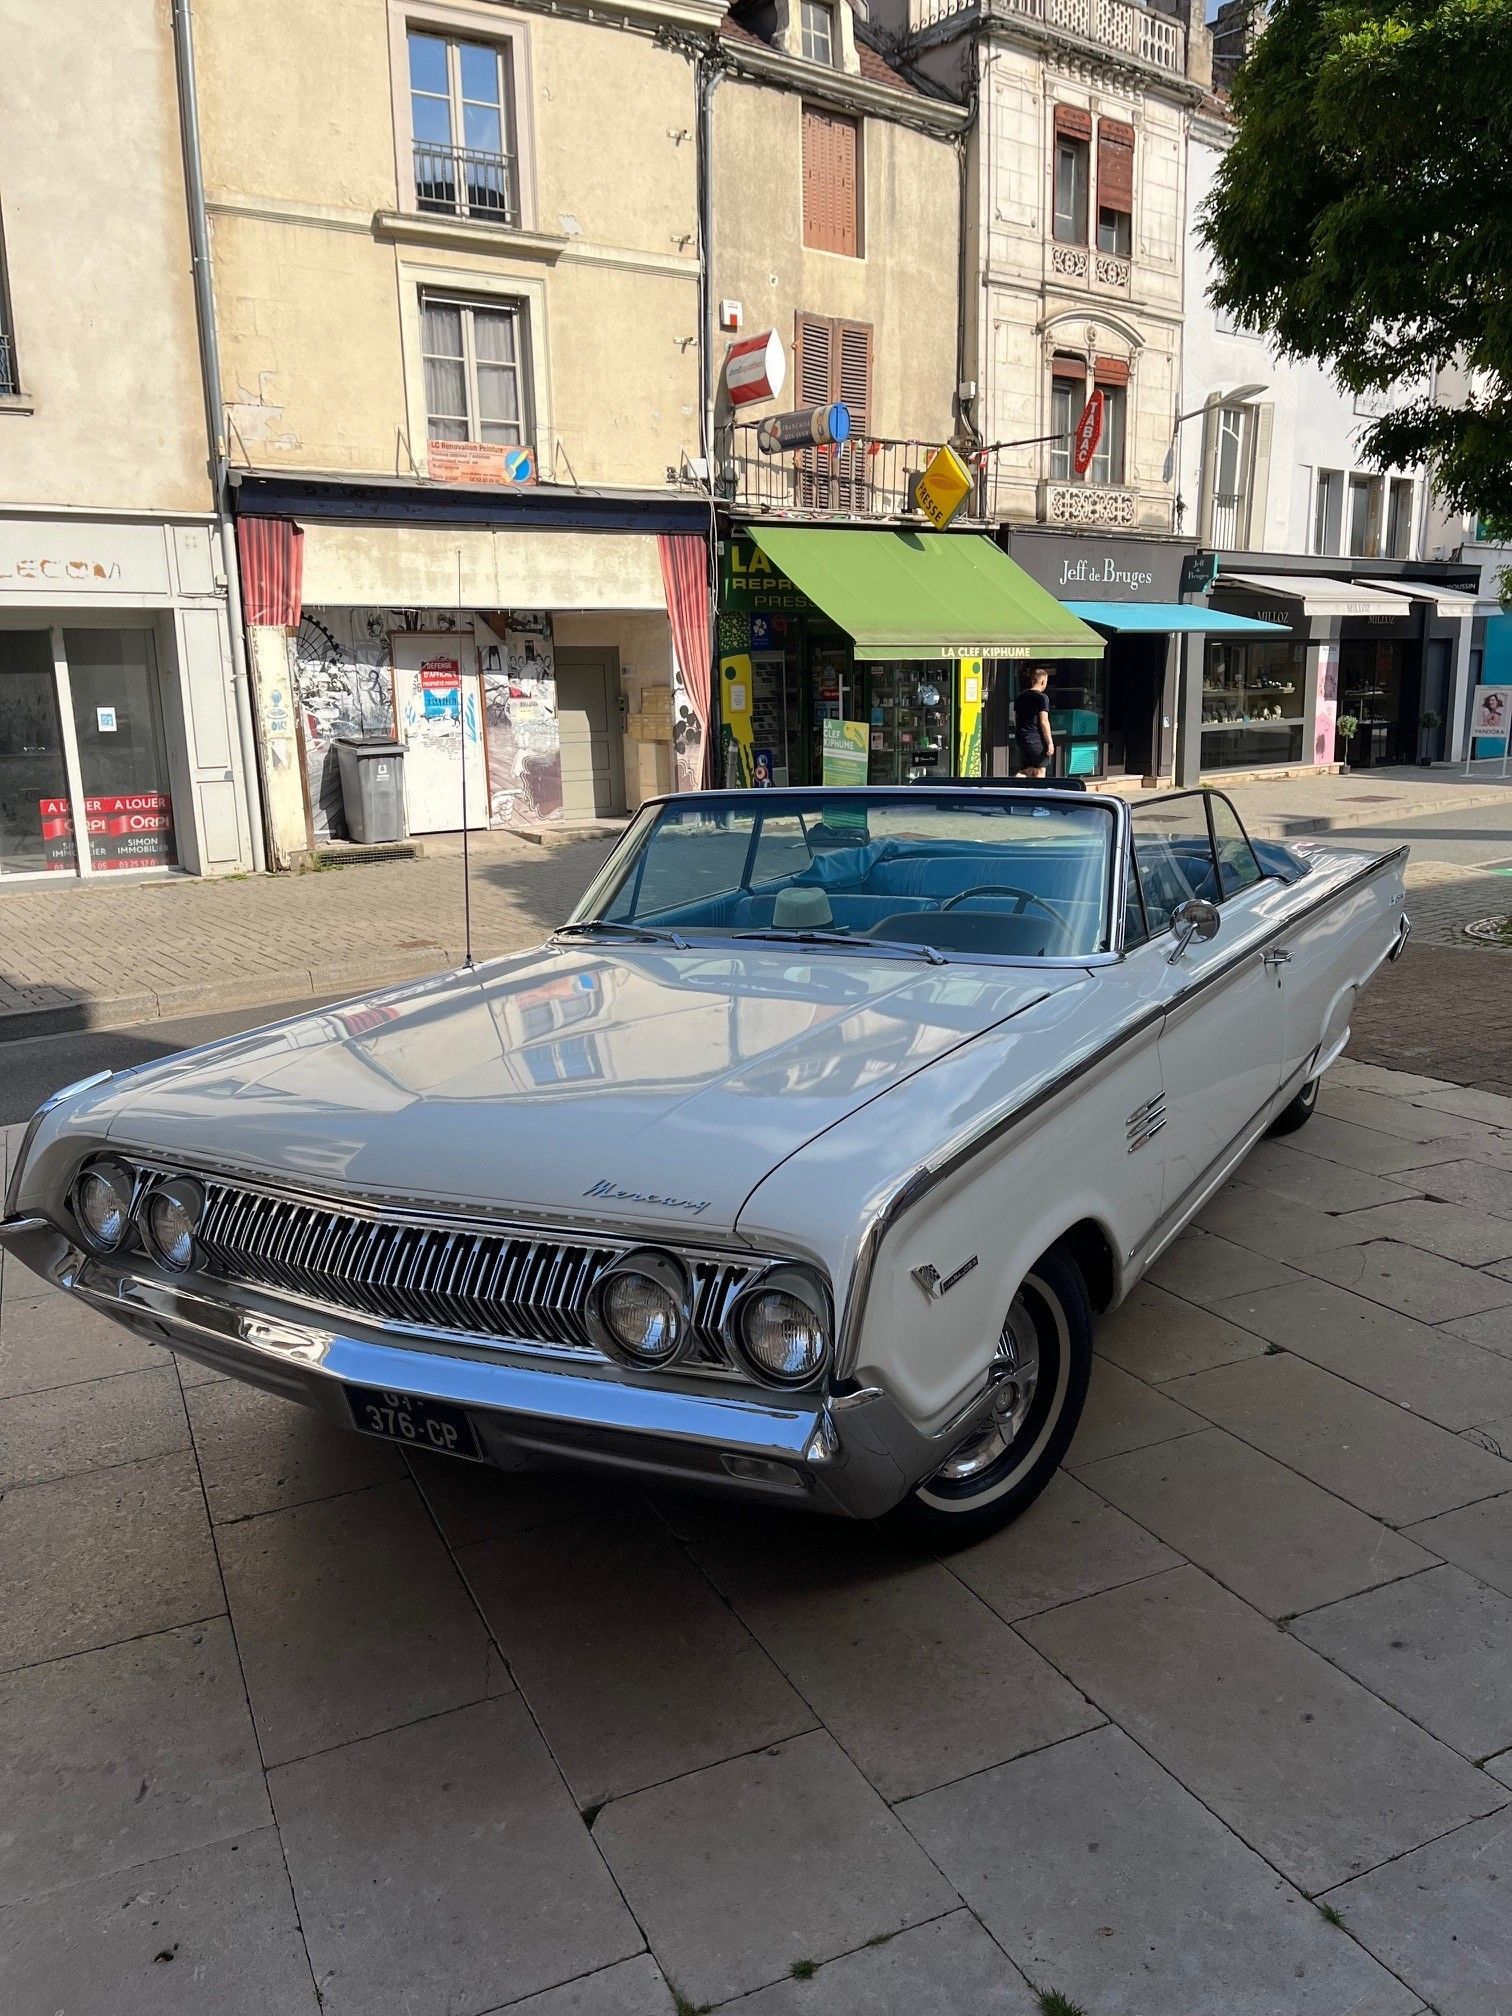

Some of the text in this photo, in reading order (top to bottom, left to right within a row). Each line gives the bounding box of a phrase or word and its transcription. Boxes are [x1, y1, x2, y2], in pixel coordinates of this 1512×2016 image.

[1079, 402, 1098, 462] TABAC
[918, 482, 943, 523] PRESSE
[731, 545, 772, 573] LA
[1059, 558, 1152, 590] Jeff de Bruges
[732, 578, 800, 590] REPR
[754, 595, 815, 608] PRES
[941, 647, 1031, 657] LA CLEF KIPHUME
[824, 720, 833, 729] LA
[824, 730, 840, 738] CLEF
[824, 738, 854, 750] KIPHUME
[48, 802, 57, 812] A
[114, 797, 166, 809] A LOUER
[130, 815, 170, 829] ORPI
[127, 838, 158, 846] SIMON
[118, 845, 168, 854] IMMOBILIER
[582, 1179, 712, 1215] Mercury
